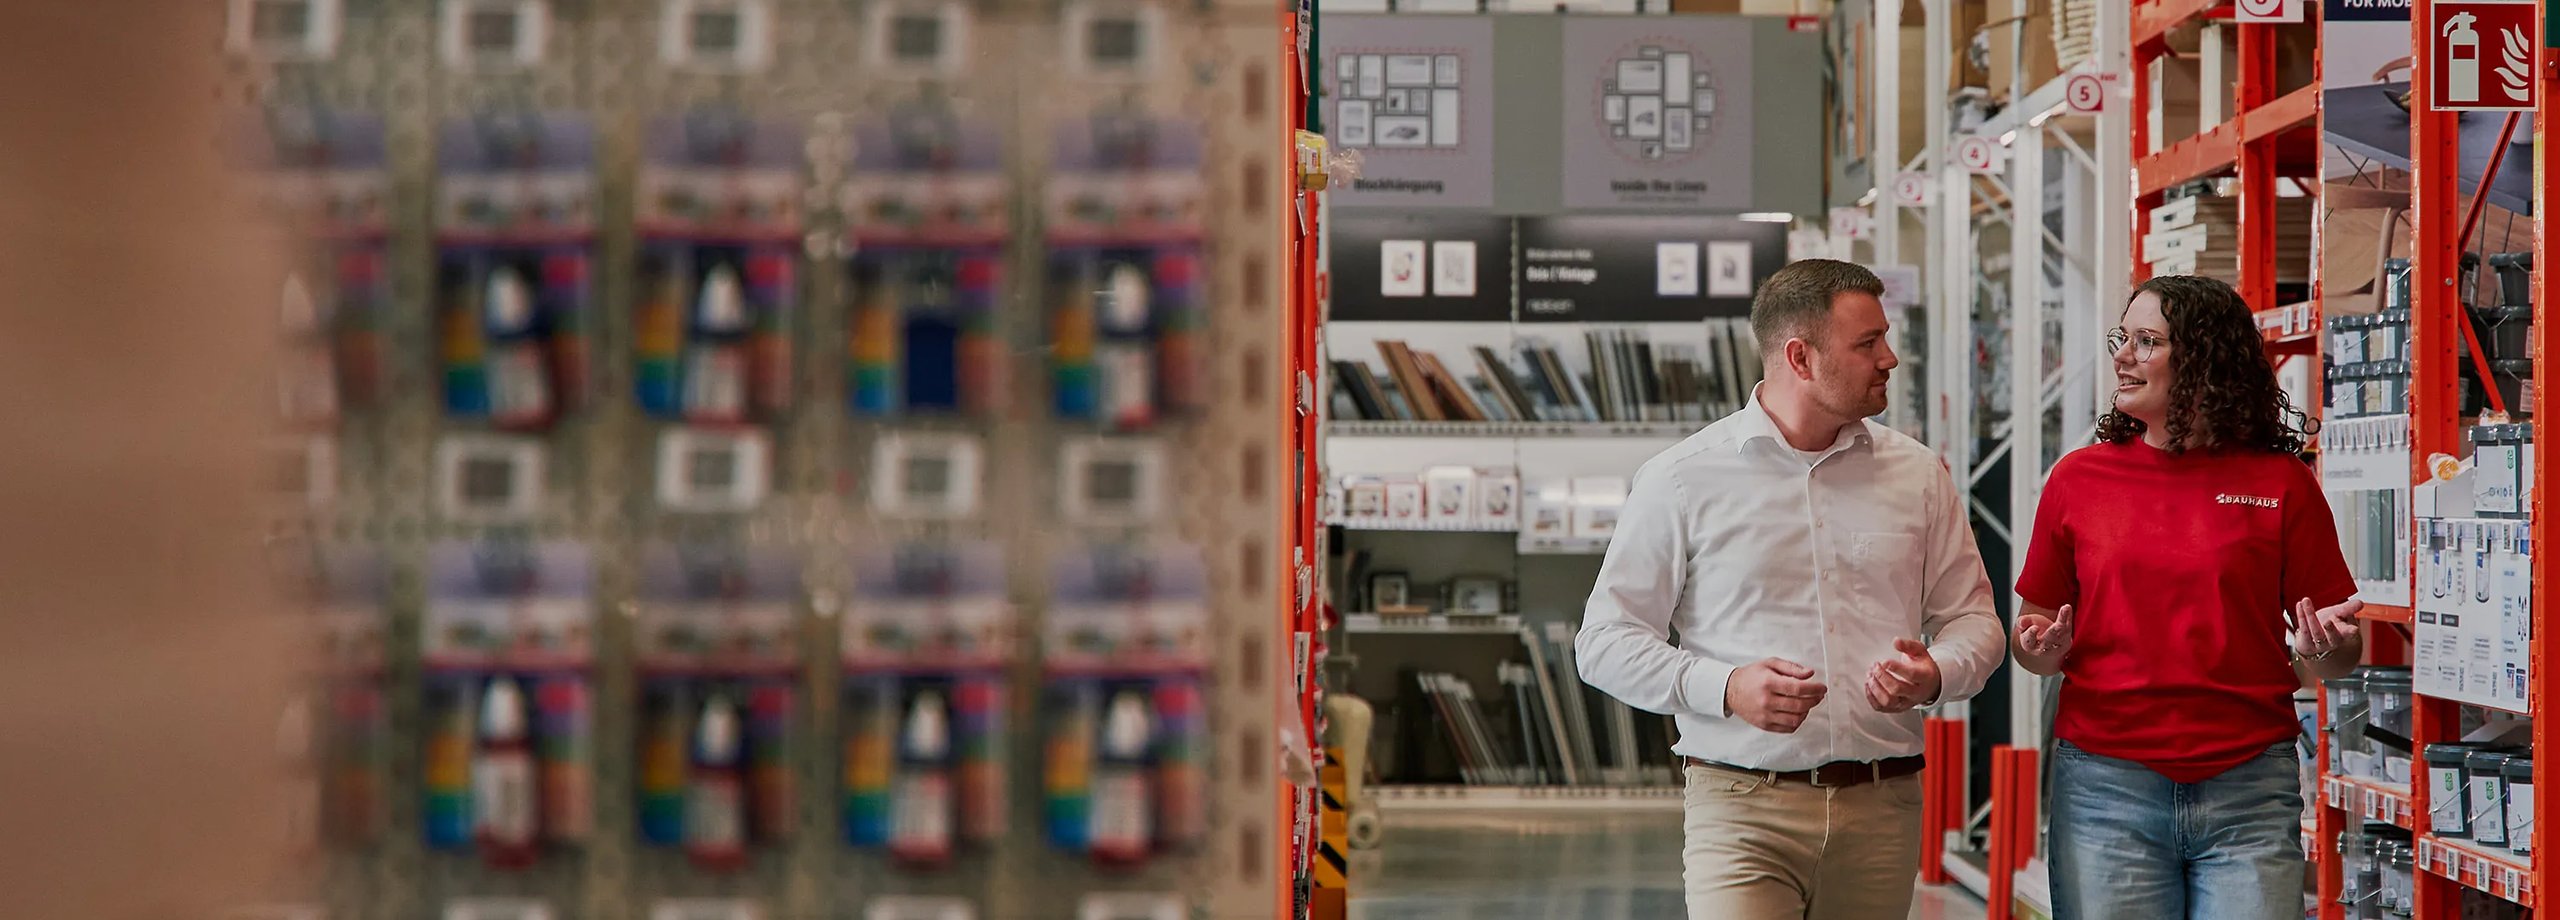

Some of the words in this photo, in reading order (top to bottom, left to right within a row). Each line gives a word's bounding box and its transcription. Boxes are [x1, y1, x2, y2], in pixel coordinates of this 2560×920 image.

[2080, 85, 2090, 102] 5
[1970, 146, 1979, 160] 4
[2224, 494, 2279, 508] BAUHAUS
